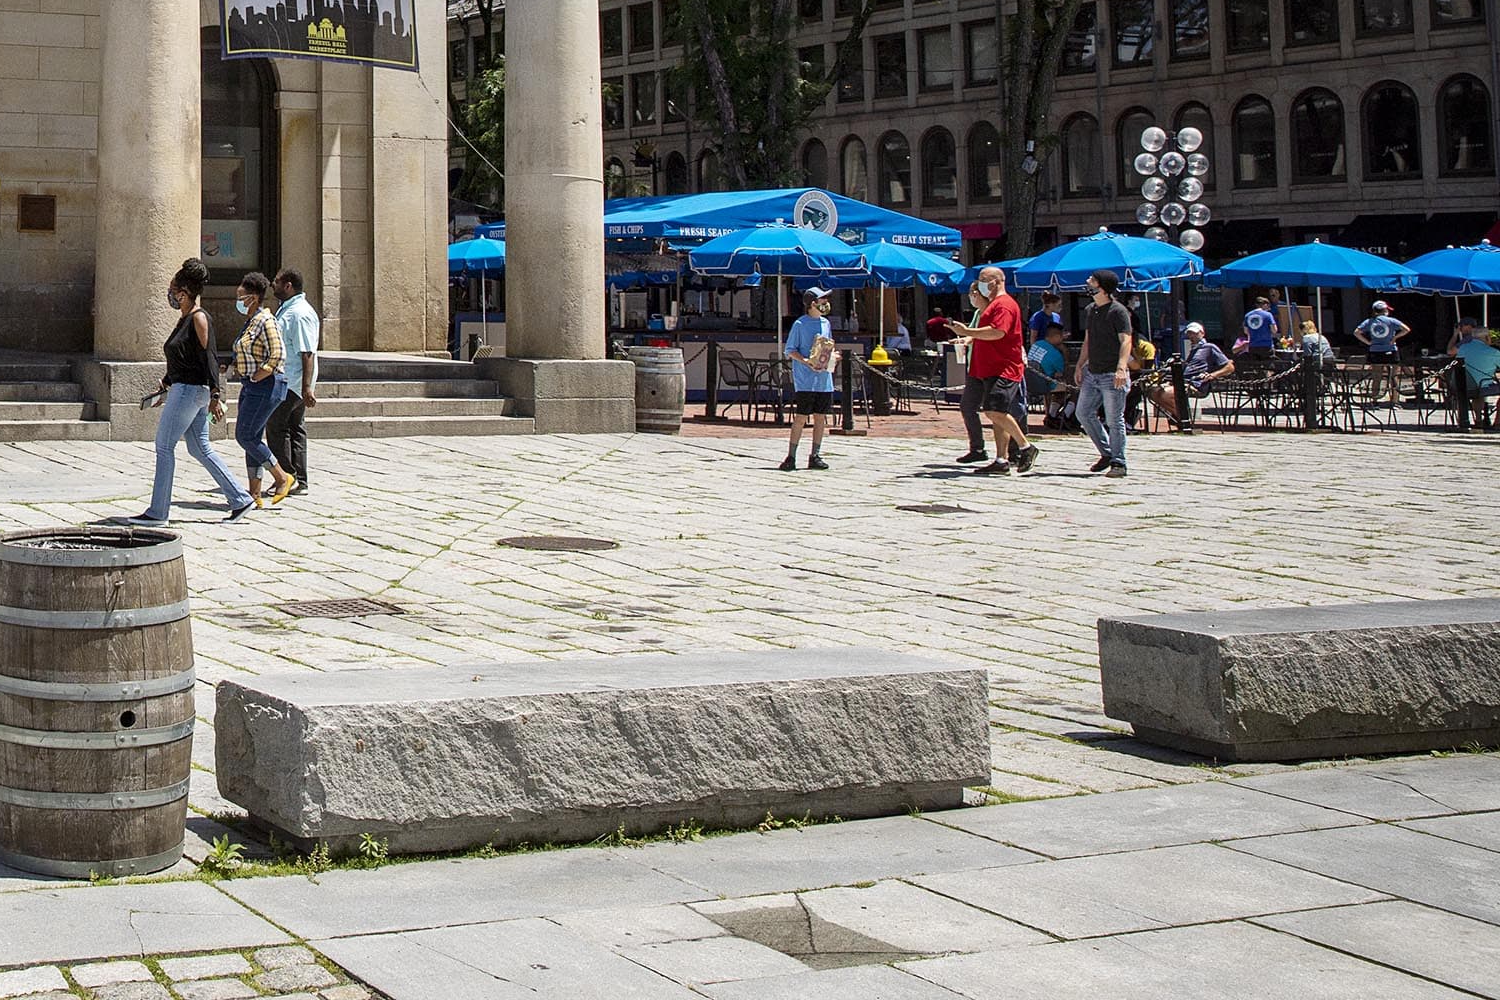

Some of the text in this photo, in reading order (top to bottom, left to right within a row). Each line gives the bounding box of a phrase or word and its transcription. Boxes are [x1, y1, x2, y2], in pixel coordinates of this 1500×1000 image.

[609, 226, 622, 235] FISH
[626, 225, 644, 235] CHIPS
[679, 226, 741, 238] FRESH SEAFO
[891, 234, 947, 246] GREAT STEAKS
